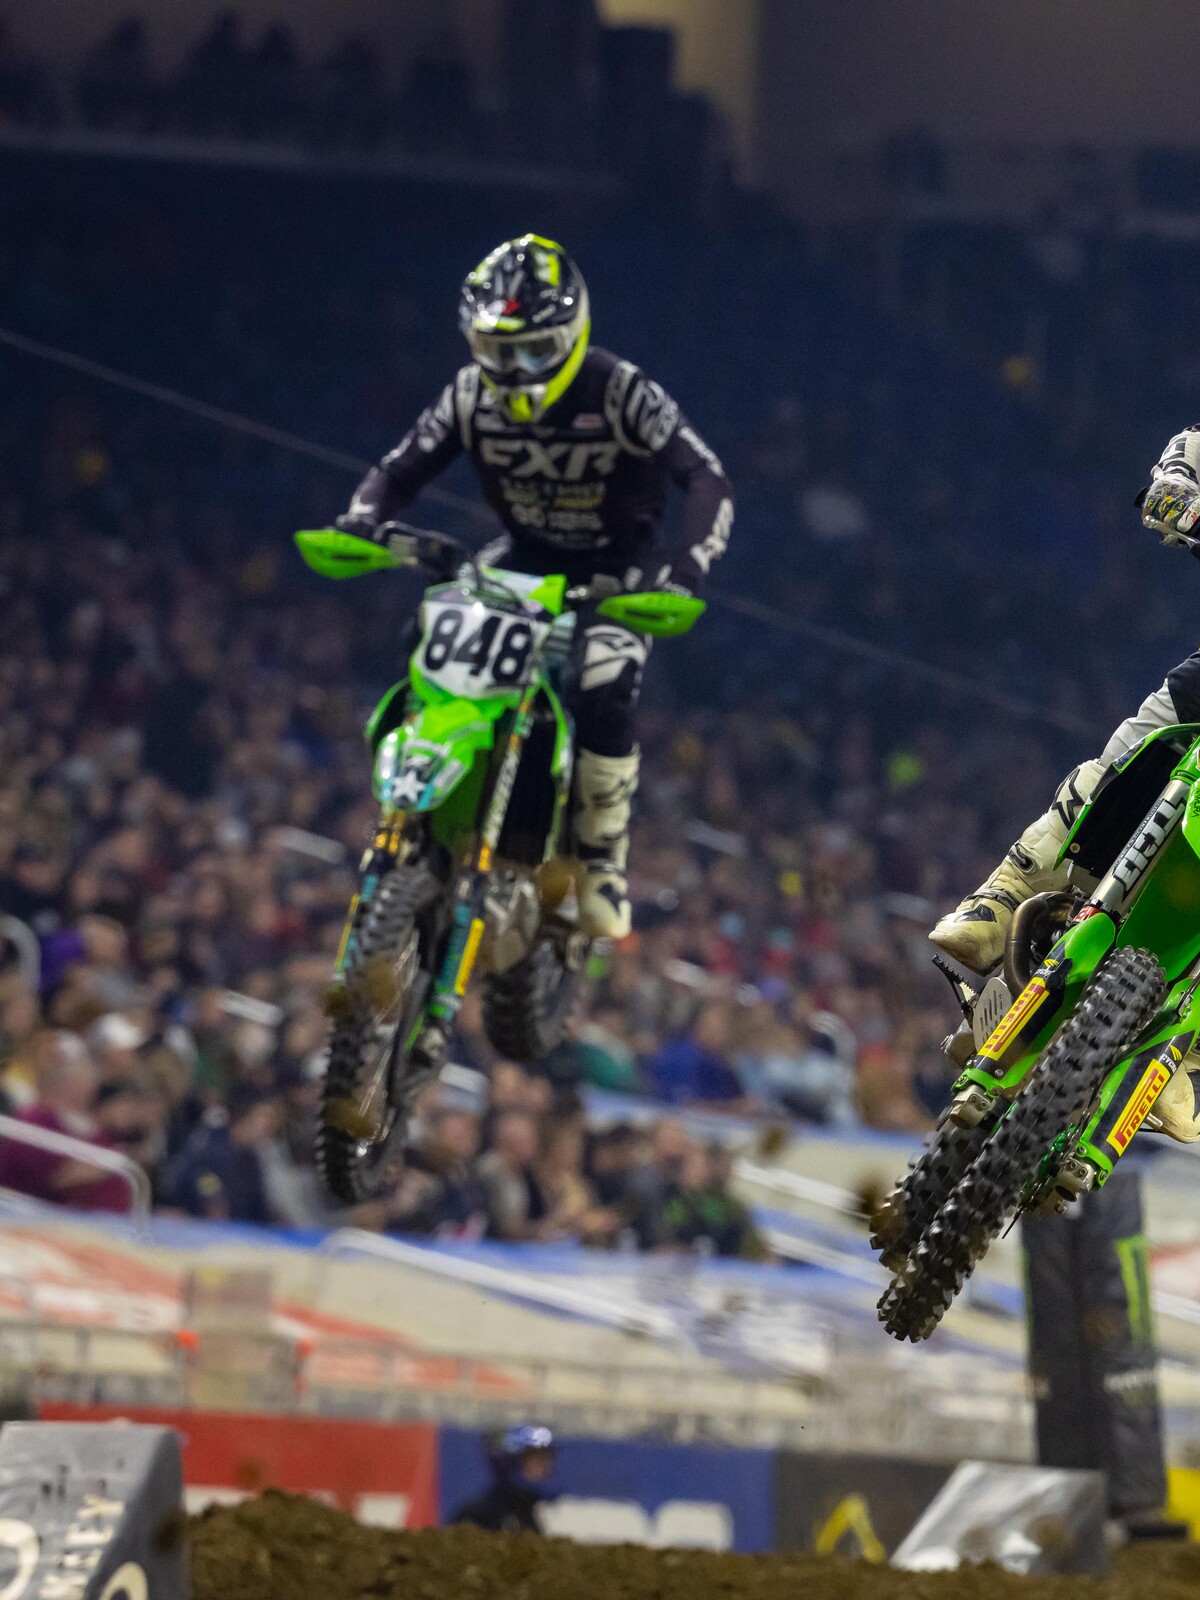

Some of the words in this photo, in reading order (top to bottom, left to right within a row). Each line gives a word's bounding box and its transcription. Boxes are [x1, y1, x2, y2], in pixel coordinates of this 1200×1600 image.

[480, 438, 620, 480] FXR
[423, 608, 535, 683] 848
[983, 982, 1047, 1053] PIRELLI
[1114, 1067, 1166, 1149] PIRELLI
